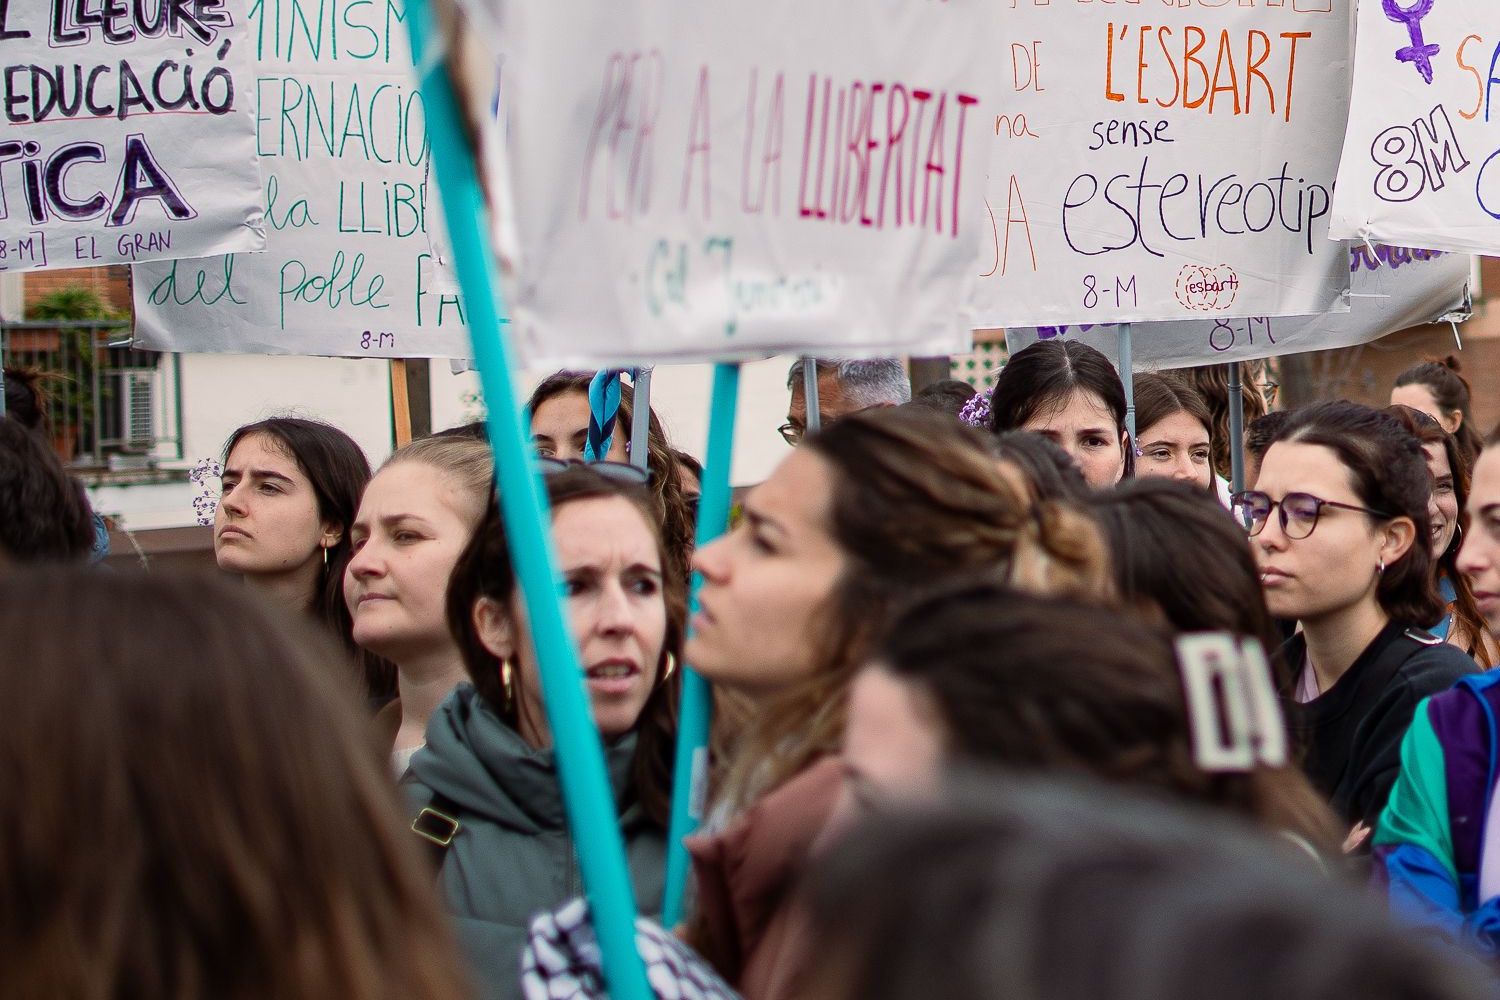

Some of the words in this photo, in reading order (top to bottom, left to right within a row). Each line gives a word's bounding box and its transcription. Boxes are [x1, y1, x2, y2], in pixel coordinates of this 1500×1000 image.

[1011, 40, 1046, 92] DE
[1105, 21, 1313, 123] L'ESBART
[799, 71, 980, 239] LLIBERTAT
[996, 113, 1040, 140] na
[1089, 118, 1176, 151] sense
[1370, 103, 1471, 203] 8M
[263, 175, 320, 231] la
[1062, 154, 1337, 258] estereotip
[75, 236, 102, 260] EL
[117, 230, 171, 261] GRAN
[147, 250, 248, 307] del
[1083, 274, 1139, 309] 8-M
[1189, 274, 1240, 294] esbart
